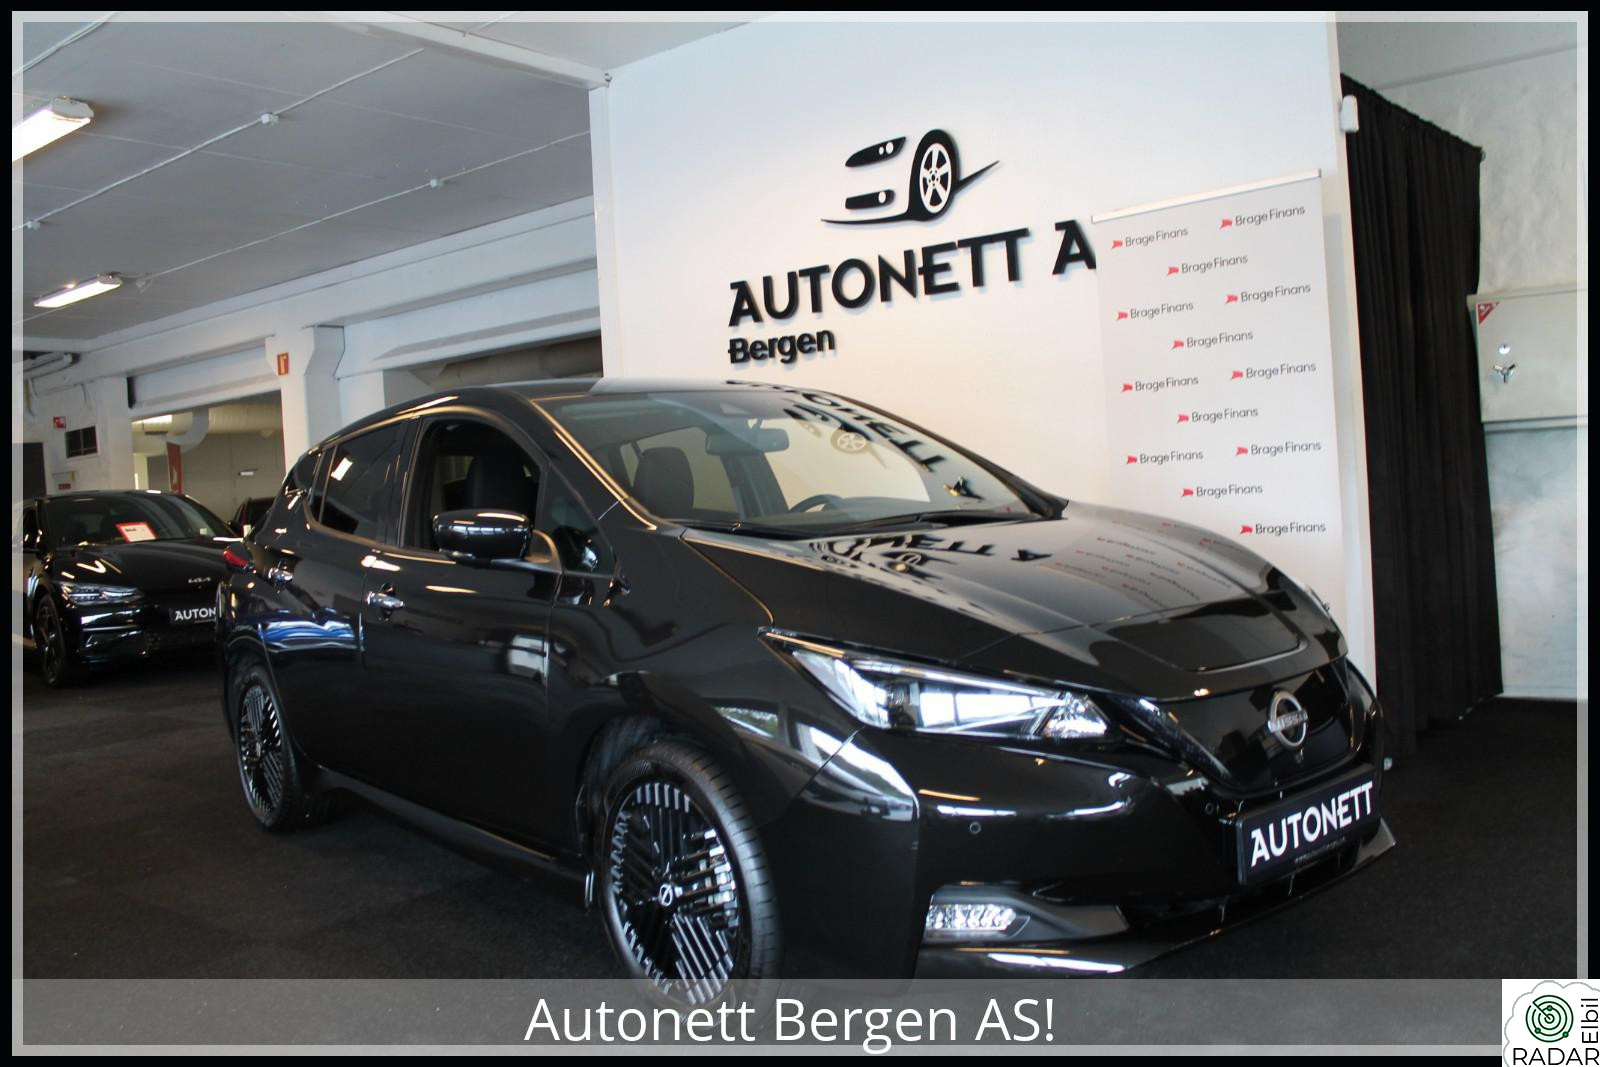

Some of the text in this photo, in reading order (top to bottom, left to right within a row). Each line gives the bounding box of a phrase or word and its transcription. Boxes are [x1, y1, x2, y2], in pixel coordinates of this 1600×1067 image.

[1235, 206, 1306, 227] Brage Finans
[1125, 228, 1189, 248] Brage Finans
[1181, 255, 1248, 274] Brage Finans
[728, 227, 1030, 326] AUTONETT
[1240, 284, 1311, 303] Brage Finans
[1129, 302, 1194, 320] Brage Finans
[727, 329, 836, 364] Bergen
[1186, 332, 1254, 348] Brage Finans
[1245, 363, 1317, 379] Brage Finans
[1134, 377, 1199, 393] Brage Finans
[1191, 408, 1259, 424] Brage Finans
[1250, 441, 1322, 457] Brage Finans
[1139, 450, 1204, 466] Brage Finans
[1196, 484, 1263, 499] Brage Finans
[1255, 521, 1326, 537] Brage Finans
[175, 607, 217, 621] AUTON
[1250, 780, 1373, 868] AUTONETT
